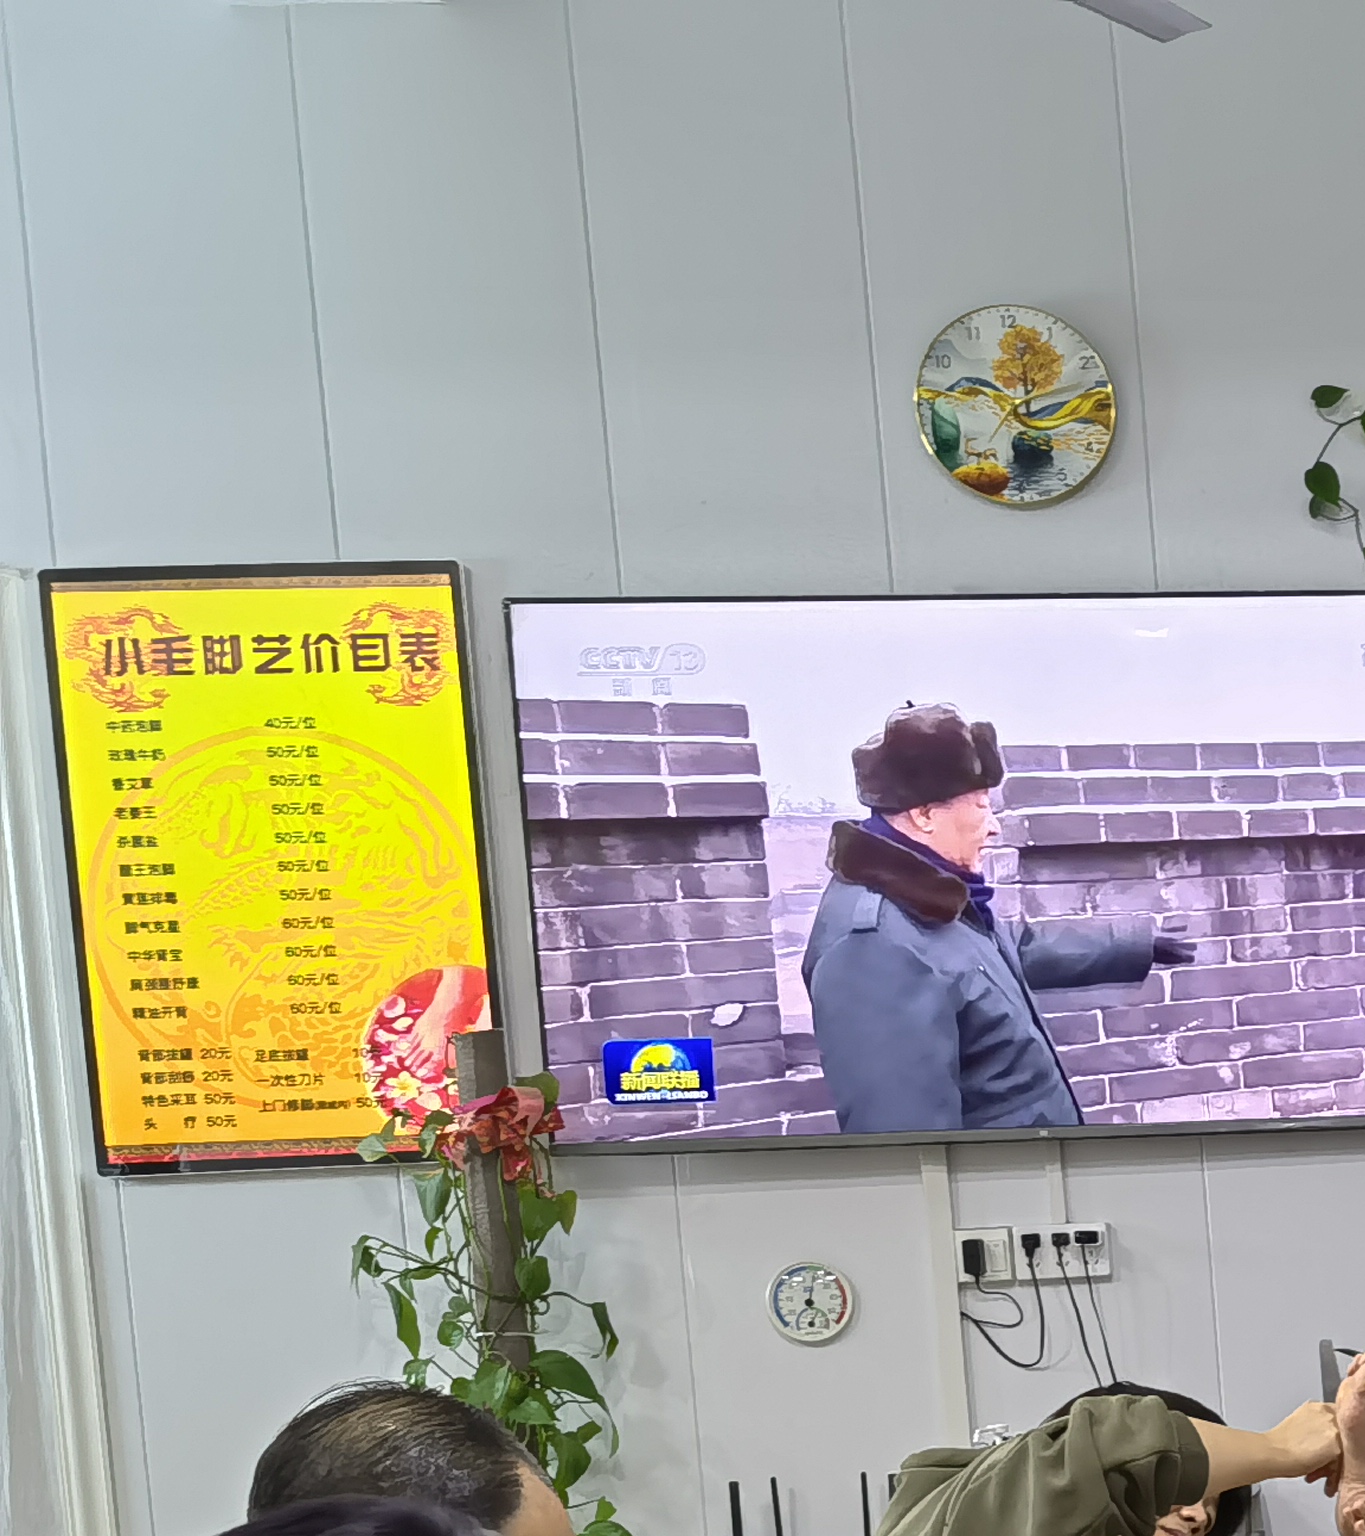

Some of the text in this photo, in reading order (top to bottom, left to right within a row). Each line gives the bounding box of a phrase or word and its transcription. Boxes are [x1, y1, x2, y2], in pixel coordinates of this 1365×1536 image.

[103, 632, 442, 677] 小毛脚艺价目表
[580, 646, 661, 670] CCTV
[264, 716, 318, 730] 40元/位
[267, 745, 320, 758] 50元/位
[269, 773, 322, 787] 50元/位
[272, 802, 325, 816] 50元/位
[274, 831, 327, 844] 50元/位
[277, 859, 330, 873] 50元/位
[280, 887, 333, 901] 50元/位
[200, 1047, 233, 1061] 20元
[202, 1069, 235, 1083] 20元
[255, 1072, 326, 1087] 一次性刀片
[204, 1092, 237, 1106] 50元
[206, 1115, 239, 1129] 50元
